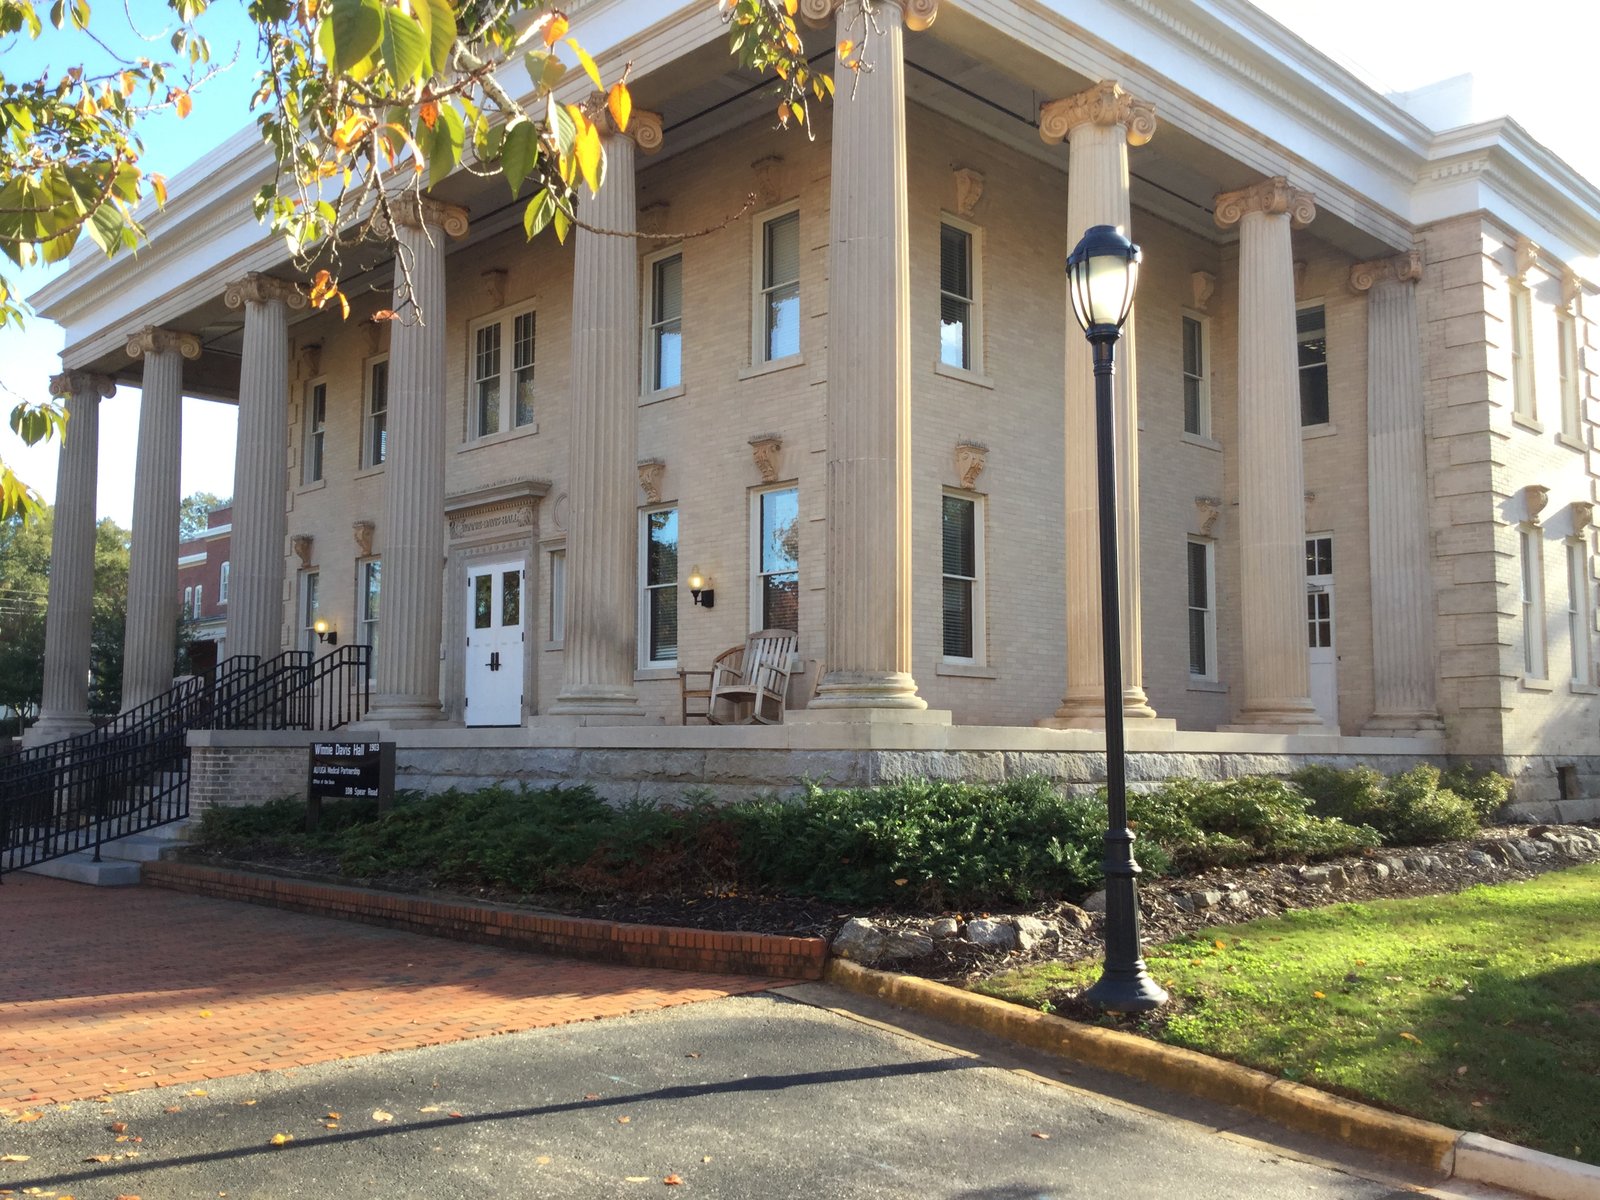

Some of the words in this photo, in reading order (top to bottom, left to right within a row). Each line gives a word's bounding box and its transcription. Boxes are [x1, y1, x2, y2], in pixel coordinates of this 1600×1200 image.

[314, 744, 334, 755] Winnie
[335, 744, 351, 755] Davis
[353, 744, 365, 755] Hall
